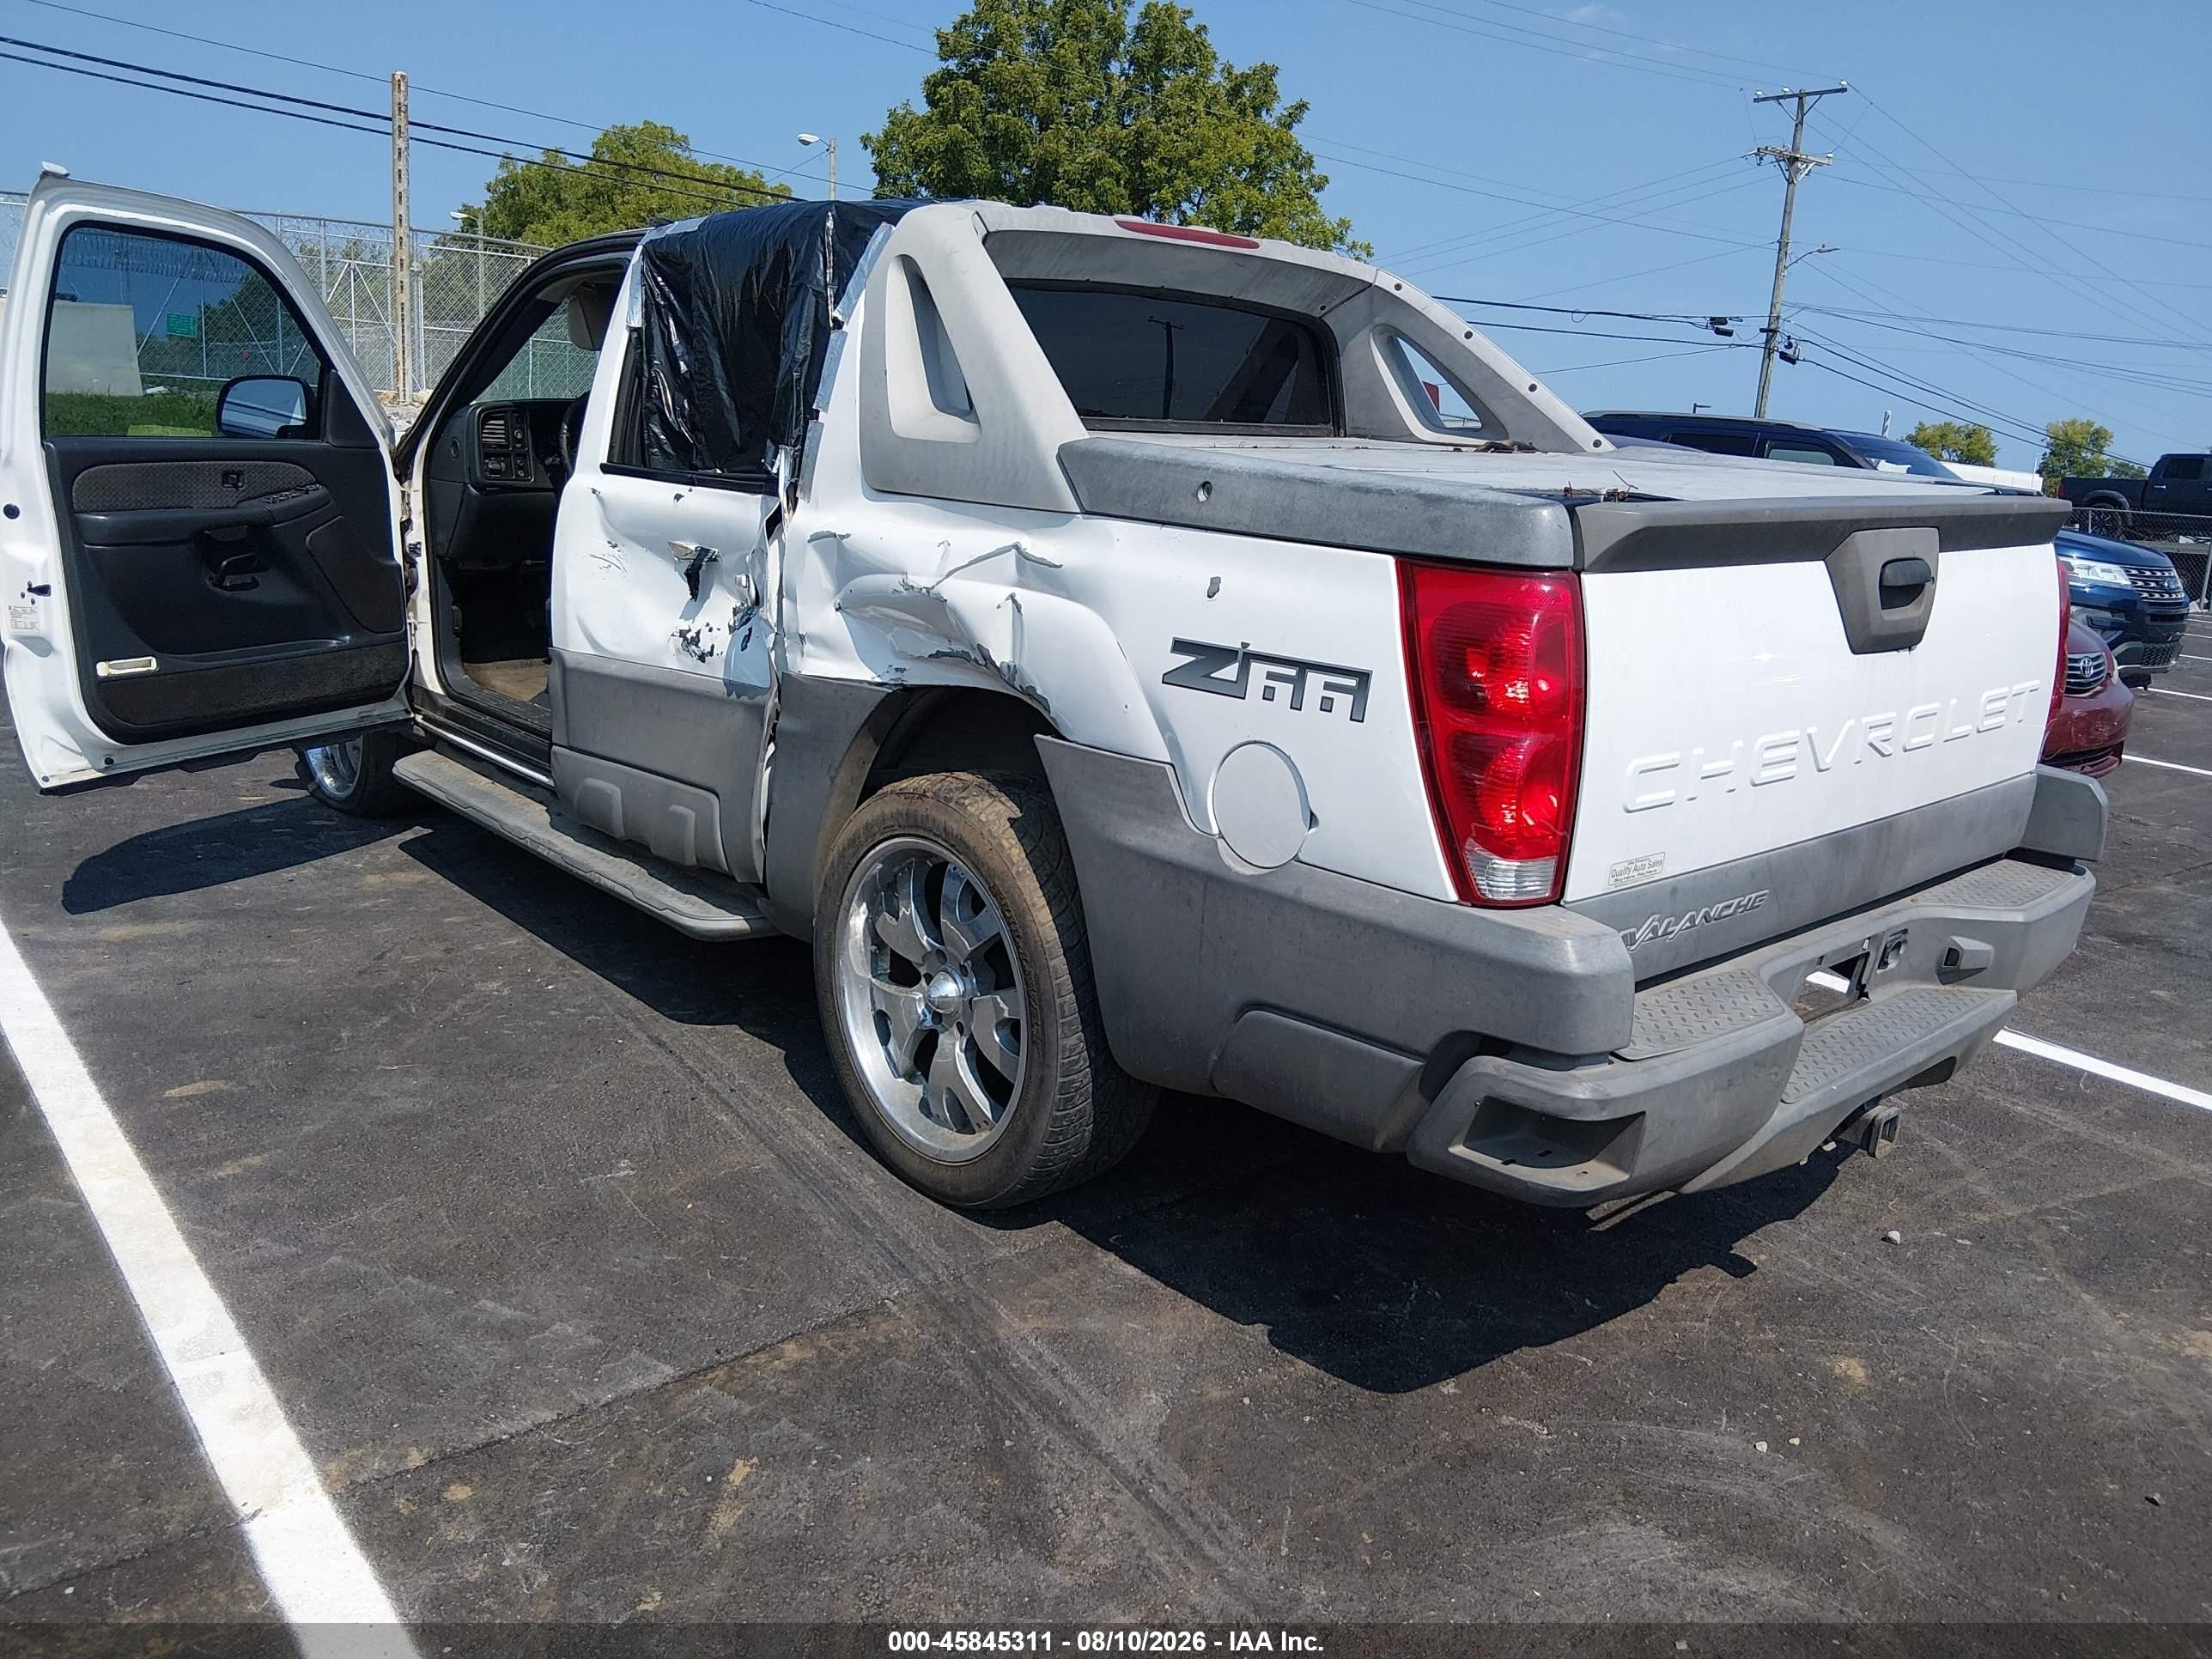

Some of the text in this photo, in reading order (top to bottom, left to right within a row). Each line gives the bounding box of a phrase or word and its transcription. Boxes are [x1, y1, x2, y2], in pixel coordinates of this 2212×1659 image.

[1622, 679, 2041, 814] CHEVROLET
[1611, 865, 1632, 878] Quality
[1632, 862, 1646, 873] Auto
[1647, 858, 1663, 869] Sales
